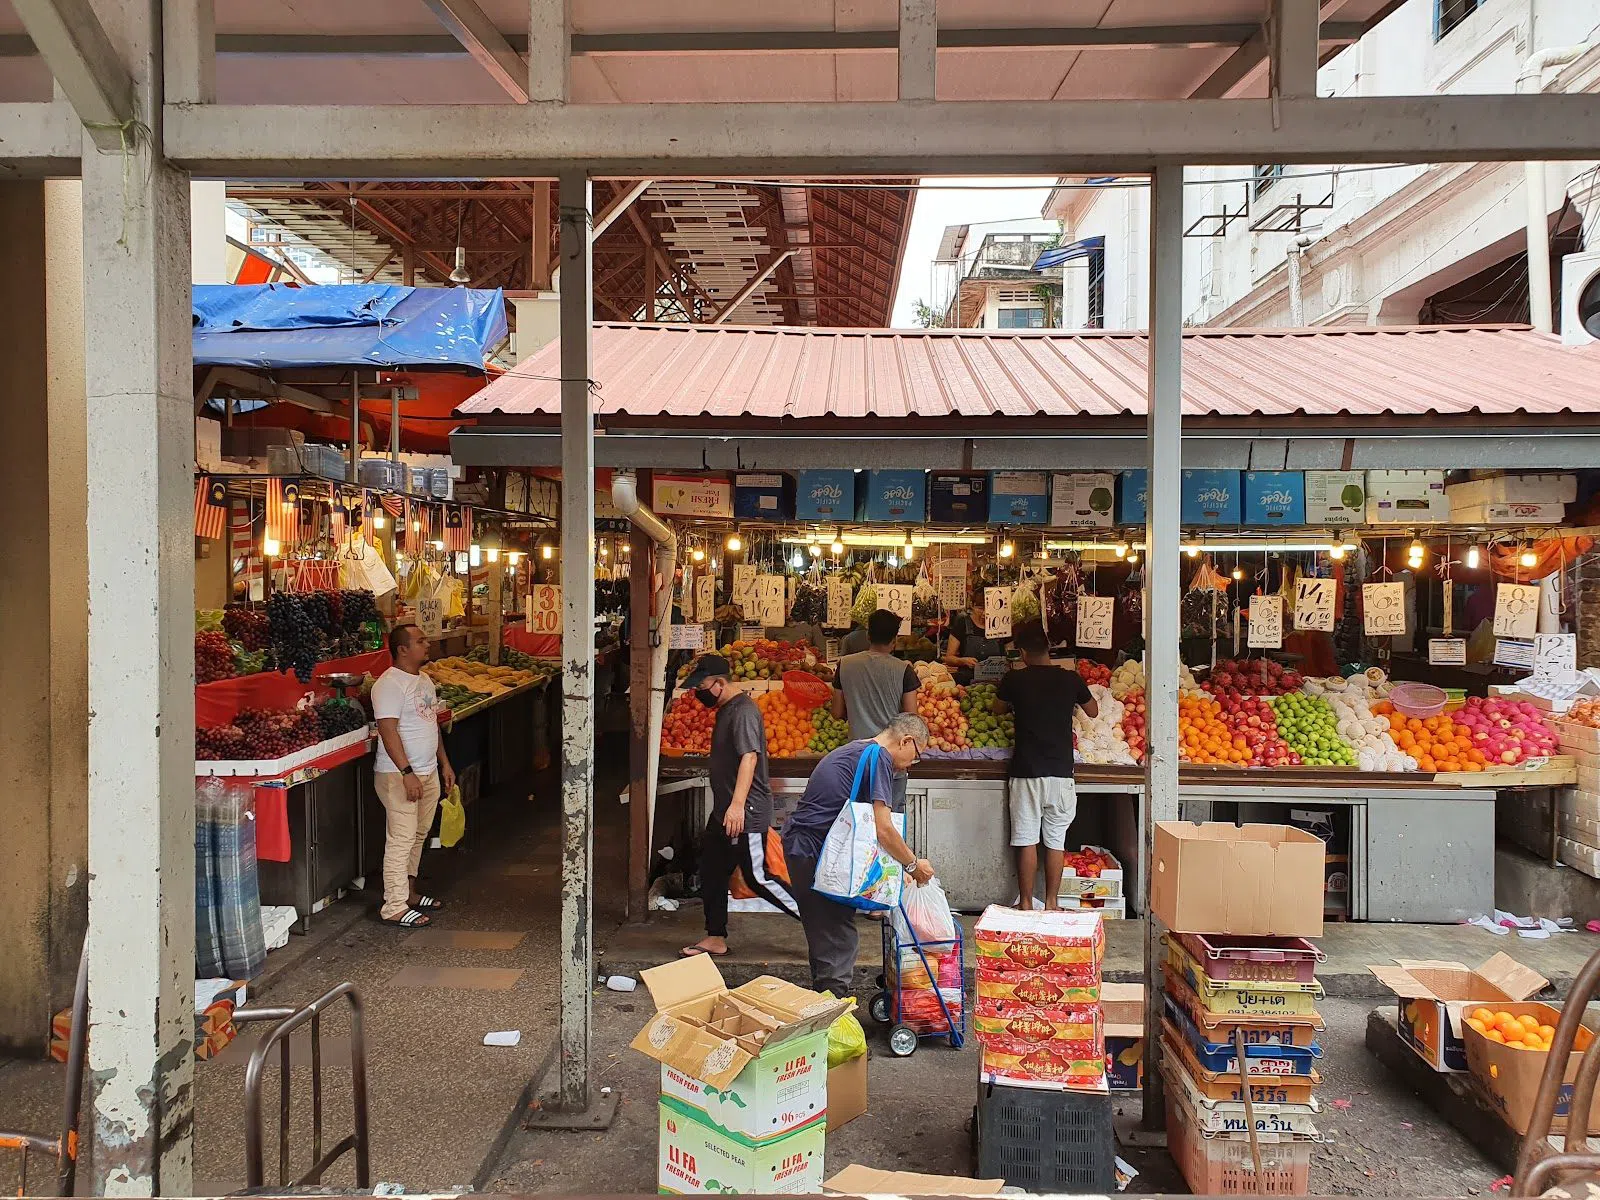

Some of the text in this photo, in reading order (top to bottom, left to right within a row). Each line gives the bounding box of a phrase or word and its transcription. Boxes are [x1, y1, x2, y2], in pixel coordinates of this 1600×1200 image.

[810, 484, 842, 498] Rose
[883, 485, 914, 499] Rose
[1196, 488, 1229, 502] Rose
[1260, 491, 1292, 505] Rose
[540, 586, 555, 610] 3
[887, 588, 903, 612] 8
[991, 589, 1004, 611] 6
[1372, 585, 1393, 610] 6
[1506, 587, 1529, 615] 8
[1083, 600, 1106, 618] 12
[1258, 599, 1273, 619] 6
[776, 1065, 812, 1083] FRESH PEAR
[784, 1056, 806, 1072] LI FA
[666, 1070, 684, 1084] FRESH
[684, 1079, 700, 1093] PEAR
[781, 1110, 794, 1126] 96
[669, 1144, 697, 1174] LI FA
[704, 1141, 746, 1167] SELECTED PEAR
[782, 1152, 803, 1170] LI FA
[665, 1163, 701, 1189] FRESH PEAR
[773, 1161, 809, 1182] FRESH PEAR
